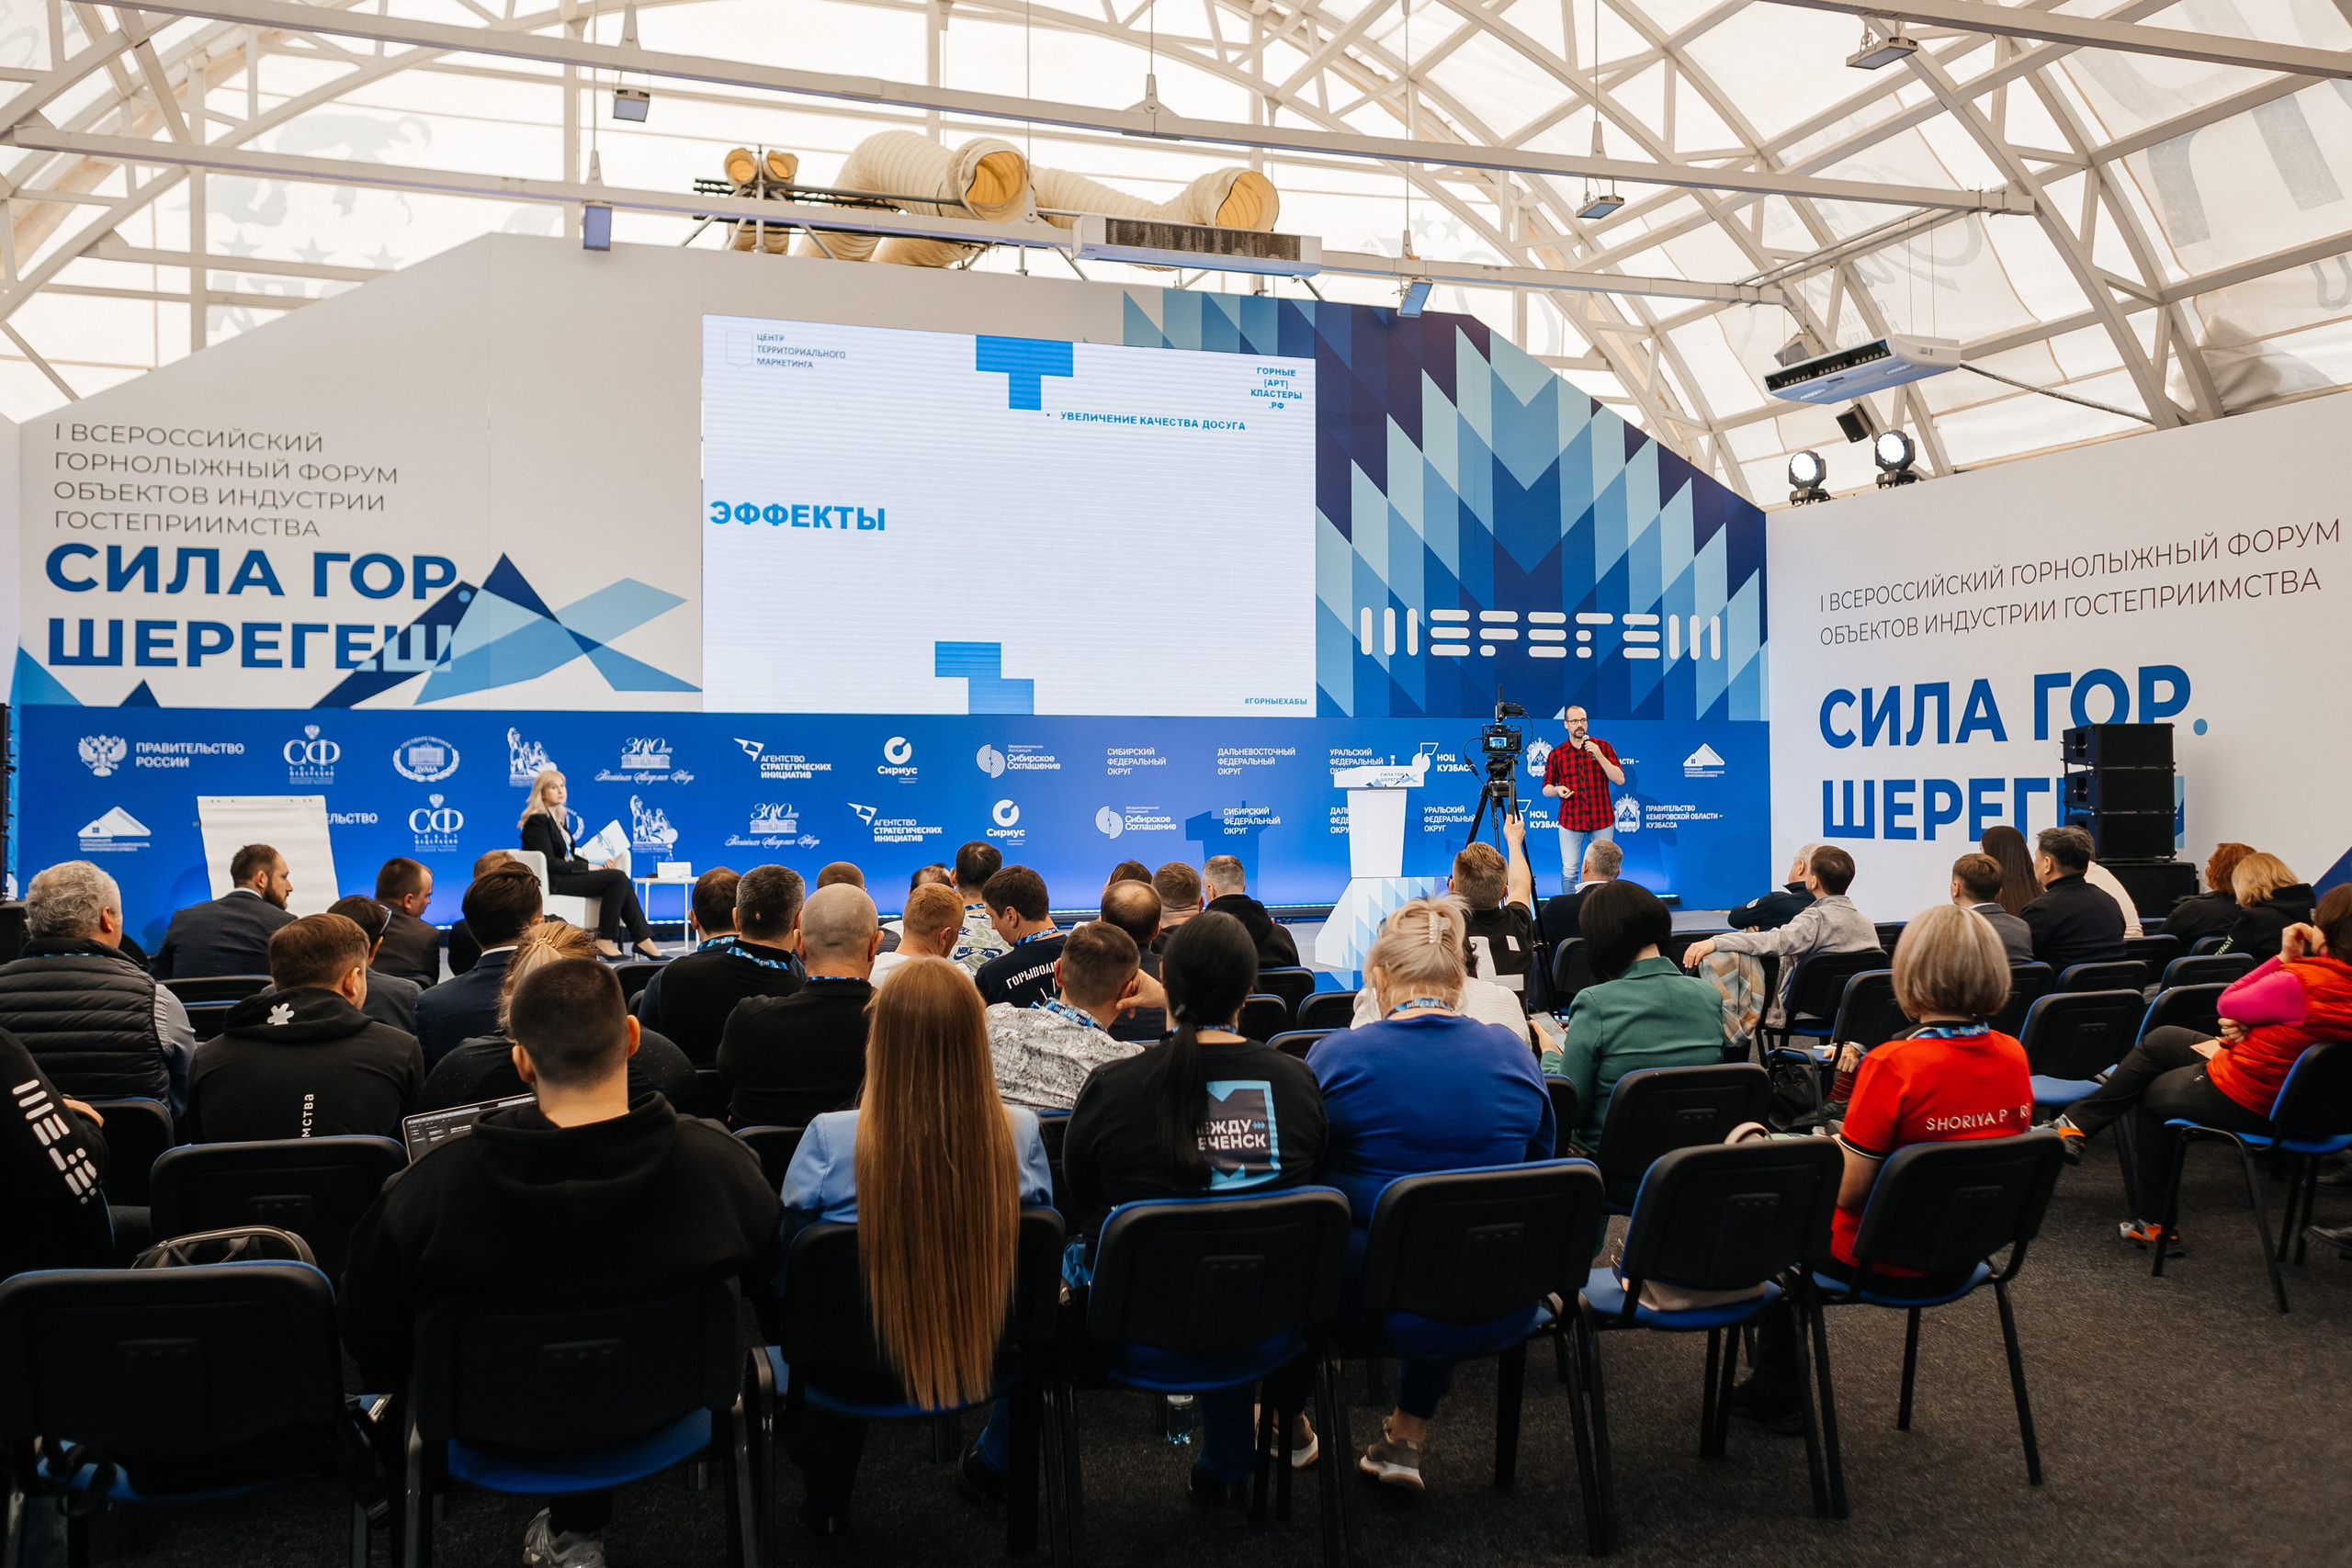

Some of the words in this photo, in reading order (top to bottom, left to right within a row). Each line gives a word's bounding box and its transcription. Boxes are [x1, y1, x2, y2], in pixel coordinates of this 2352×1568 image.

[757, 333, 785, 342] ЦЕНТР
[757, 345, 846, 359] ТЕРРИТОРИАЛЬНОГО
[757, 358, 813, 368] МАРКЕТИНГА
[1257, 367, 1296, 378] ГОРНЫЕ
[1250, 389, 1303, 400] КЛАСТЕРЫ
[1060, 412, 1137, 424] УВЕЛИЧЕНИЕ
[1140, 417, 1199, 428] КАЧЕСТВА
[1202, 421, 1246, 431] ДОСУГА
[72, 423, 322, 453] ВСЕРОССИЙСКИЙ
[54, 451, 290, 479] ГОРНОЛЫЖНЫЙ
[297, 462, 398, 484] ФОРУМ
[53, 480, 209, 504] ОБЪЕКТОВ
[217, 488, 386, 512] ИНДУСТРИИ
[709, 500, 886, 531] ЭФФЕКТЫ
[55, 510, 320, 537] ГОСТЕПРИИМСТВА
[45, 542, 285, 597] СИЛА
[1829, 565, 2004, 611] ВСЕРОССИЙСКИЙ
[2011, 532, 2218, 587] ГОРНОЛЫЖНЫЙ
[2227, 519, 2340, 558] ФОРУМ
[1820, 616, 1918, 646] ОБЪЕКТОВ
[1925, 601, 2056, 635] ИНДУСТРИИ
[2064, 568, 2322, 619] ГОСТЕПРИИМСТВА
[47, 617, 452, 673] ШЕРЕГЕШ
[1819, 679, 2007, 750] СИЛА
[135, 742, 245, 755] ПРАВИТЕЛЬСТВО
[283, 739, 341, 766] СФ
[1107, 747, 1155, 756] СИБИРСКИЙ
[1217, 747, 1296, 756] ДАЛЬНЕВОСТОЧНЫЙ
[1329, 748, 1373, 756] УРАЛЬСКИЙ
[135, 756, 190, 768] РОССИИ
[1007, 754, 1055, 762] Сибирское
[1107, 757, 1167, 766] ФЕДЕРАЛЬНЫЙ
[1217, 757, 1275, 766] ФЕДЕРАЛЬНЫЙ
[1329, 757, 1384, 766] ФЕДЕРАЛЬНЫЙ
[1437, 753, 1455, 762] НОЦ
[877, 765, 918, 776] Сириус
[1217, 767, 1242, 775] ОКРУГ
[1437, 764, 1471, 773] КУЗБАС
[761, 771, 811, 780] ИНИЦИАТИВ
[1223, 807, 1270, 816] СИБИРСКИЙ
[1530, 810, 1548, 819] НОЦ
[1645, 812, 1690, 820] КЕМЕРОВСКОЙ
[409, 807, 464, 834] СФ
[874, 818, 916, 827] АГЕНТСТВО
[1125, 815, 1171, 824] Сибирское
[1223, 817, 1281, 826] ФЕДЕРАЛЬНЫЙ
[1424, 814, 1476, 823] ФЕДЕРАЛЬНЫЙ
[1530, 820, 1560, 829] КУЗБАС
[986, 829, 1025, 839] Сириус
[1224, 827, 1248, 835] ОКРУГ
[1330, 826, 1350, 834] ОКРУ
[874, 835, 923, 843] ИНИЦИАТИВ
[1926, 1112, 1996, 1131] SHORIYA
